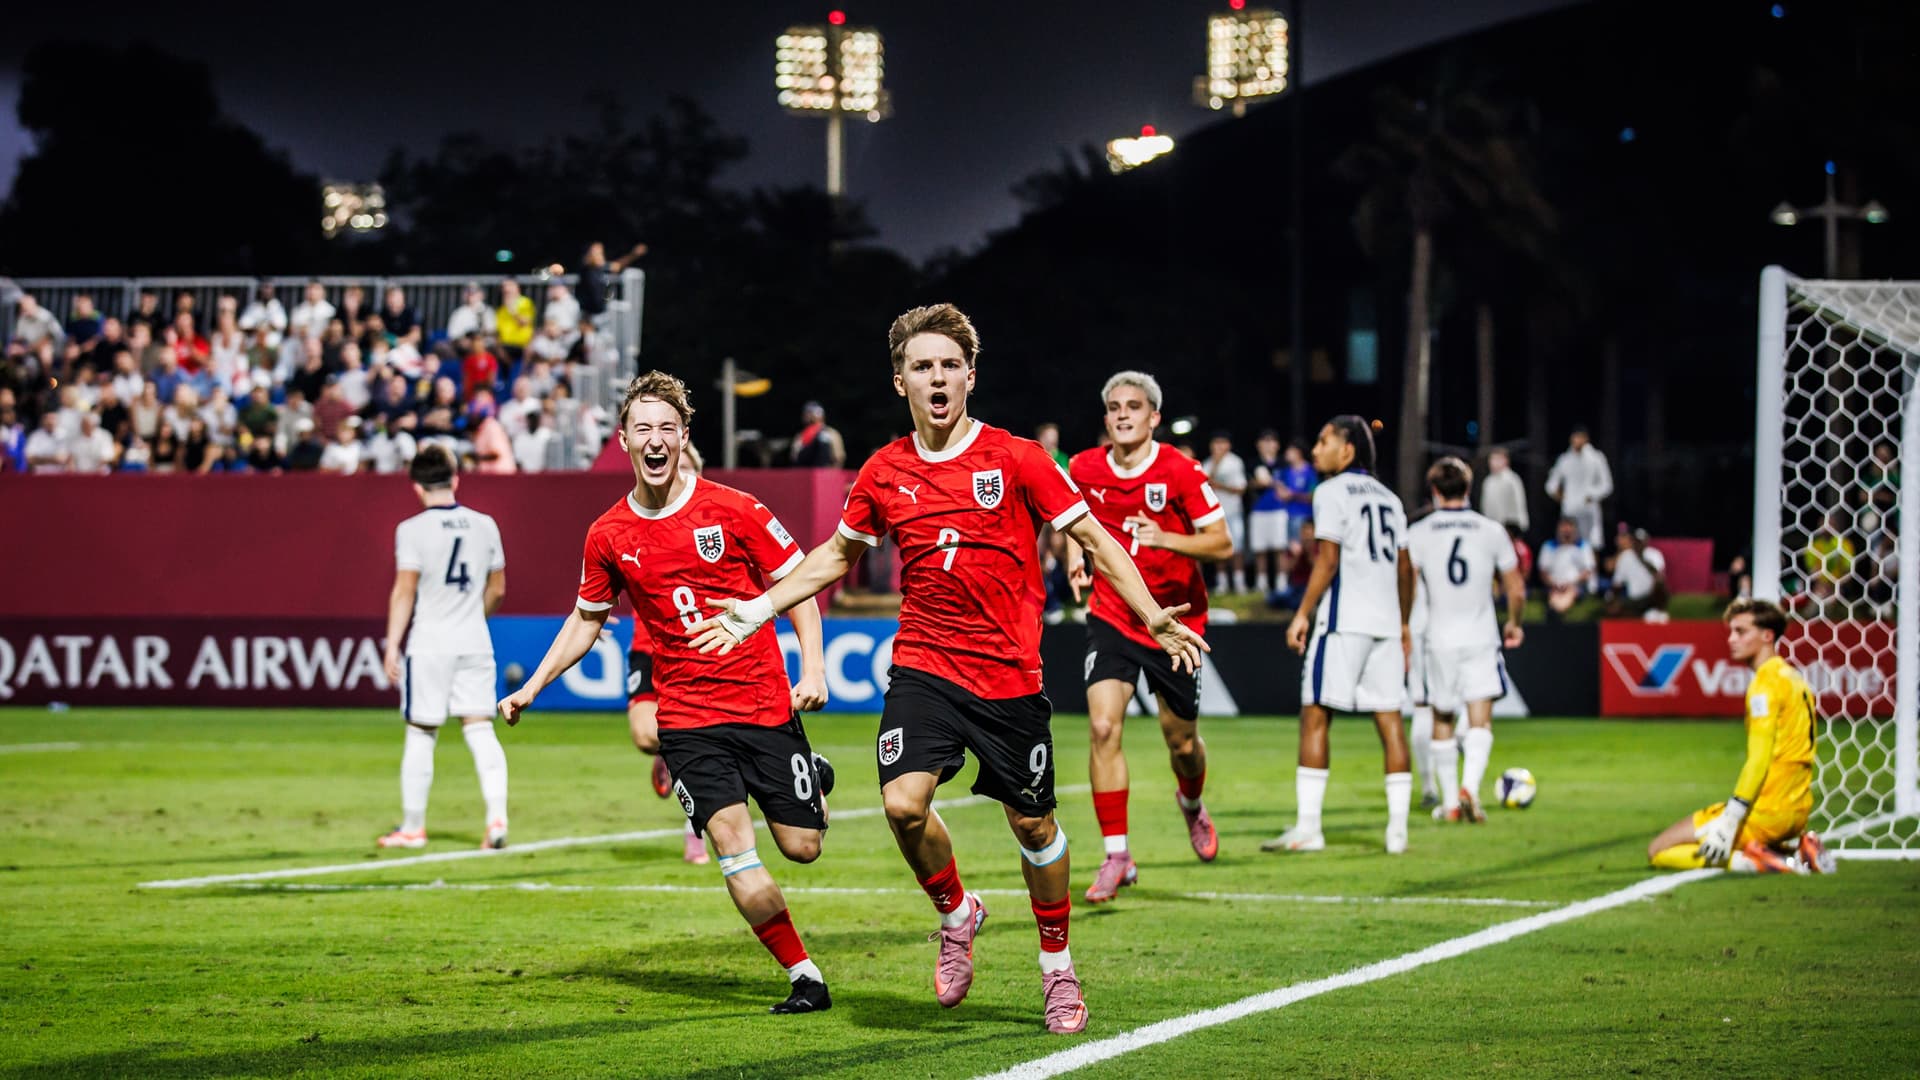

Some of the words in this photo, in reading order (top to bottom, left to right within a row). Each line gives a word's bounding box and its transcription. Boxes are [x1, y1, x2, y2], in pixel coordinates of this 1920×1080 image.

[936, 528, 960, 571] 9
[1122, 518, 1139, 556] 7
[1361, 503, 1394, 562] 15
[445, 537, 471, 592] 4
[1448, 534, 1468, 585] 6
[672, 586, 703, 630] 8
[188, 636, 390, 689] AIRWA
[1692, 659, 1886, 697] Valine
[791, 753, 812, 800] 8
[1029, 743, 1047, 787] 9
